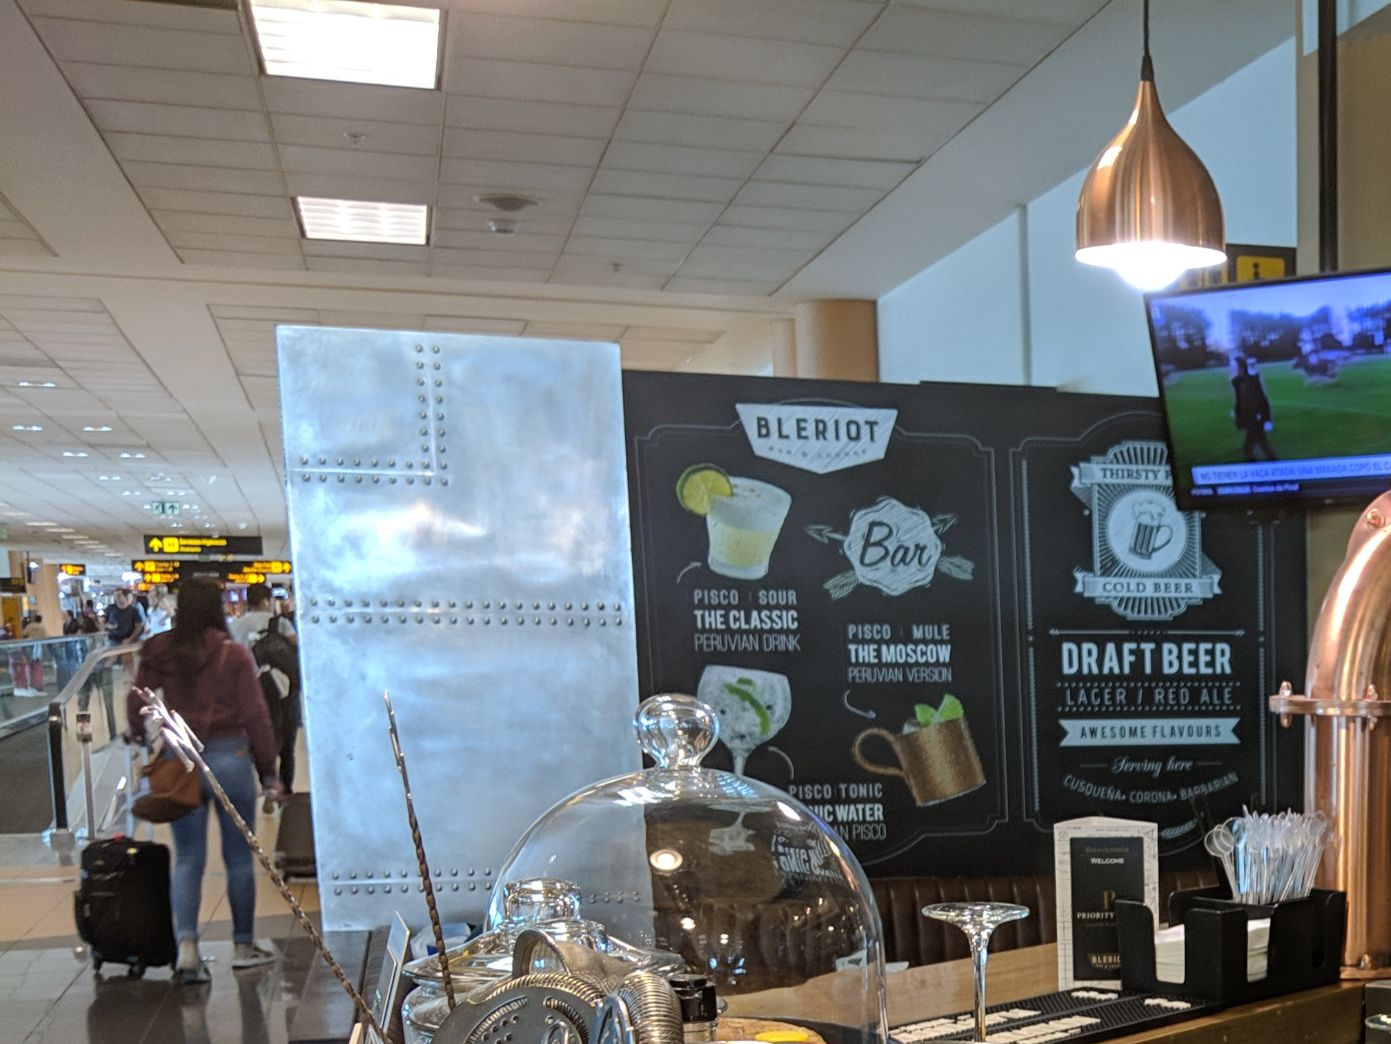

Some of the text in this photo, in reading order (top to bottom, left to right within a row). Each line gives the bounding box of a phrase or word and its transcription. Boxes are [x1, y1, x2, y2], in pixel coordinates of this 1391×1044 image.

[756, 416, 879, 443] BLERIOT
[1101, 467, 1163, 480] THIRSTY
[859, 521, 932, 570] Bar
[1103, 582, 1194, 594] COLD BEER
[693, 589, 797, 605] PISCO SOUR
[694, 609, 798, 630] THE CLASSIC
[848, 624, 950, 640] PISCO MULE
[694, 633, 801, 651] PERUVIAN DRINK
[848, 644, 951, 664] THE MOSCOW
[1061, 642, 1232, 675] DRAFT BEER
[848, 667, 952, 682] PERUVIAN VERSION
[1065, 688, 1127, 705] LAGER
[1154, 688, 1190, 705] RED
[1200, 687, 1233, 704] ALE
[1080, 724, 1222, 739] AWESOME FLAVOURS
[1111, 754, 1194, 778] Serving here
[789, 783, 883, 799] PISCO TONIC
[1180, 772, 1239, 800] BARBARIAN
[835, 804, 884, 821] WATER
[852, 823, 887, 840] PISCO
[1090, 857, 1125, 865] WELCOME
[1076, 912, 1115, 920] PRIORITY
[1091, 955, 1121, 965] BLERI
